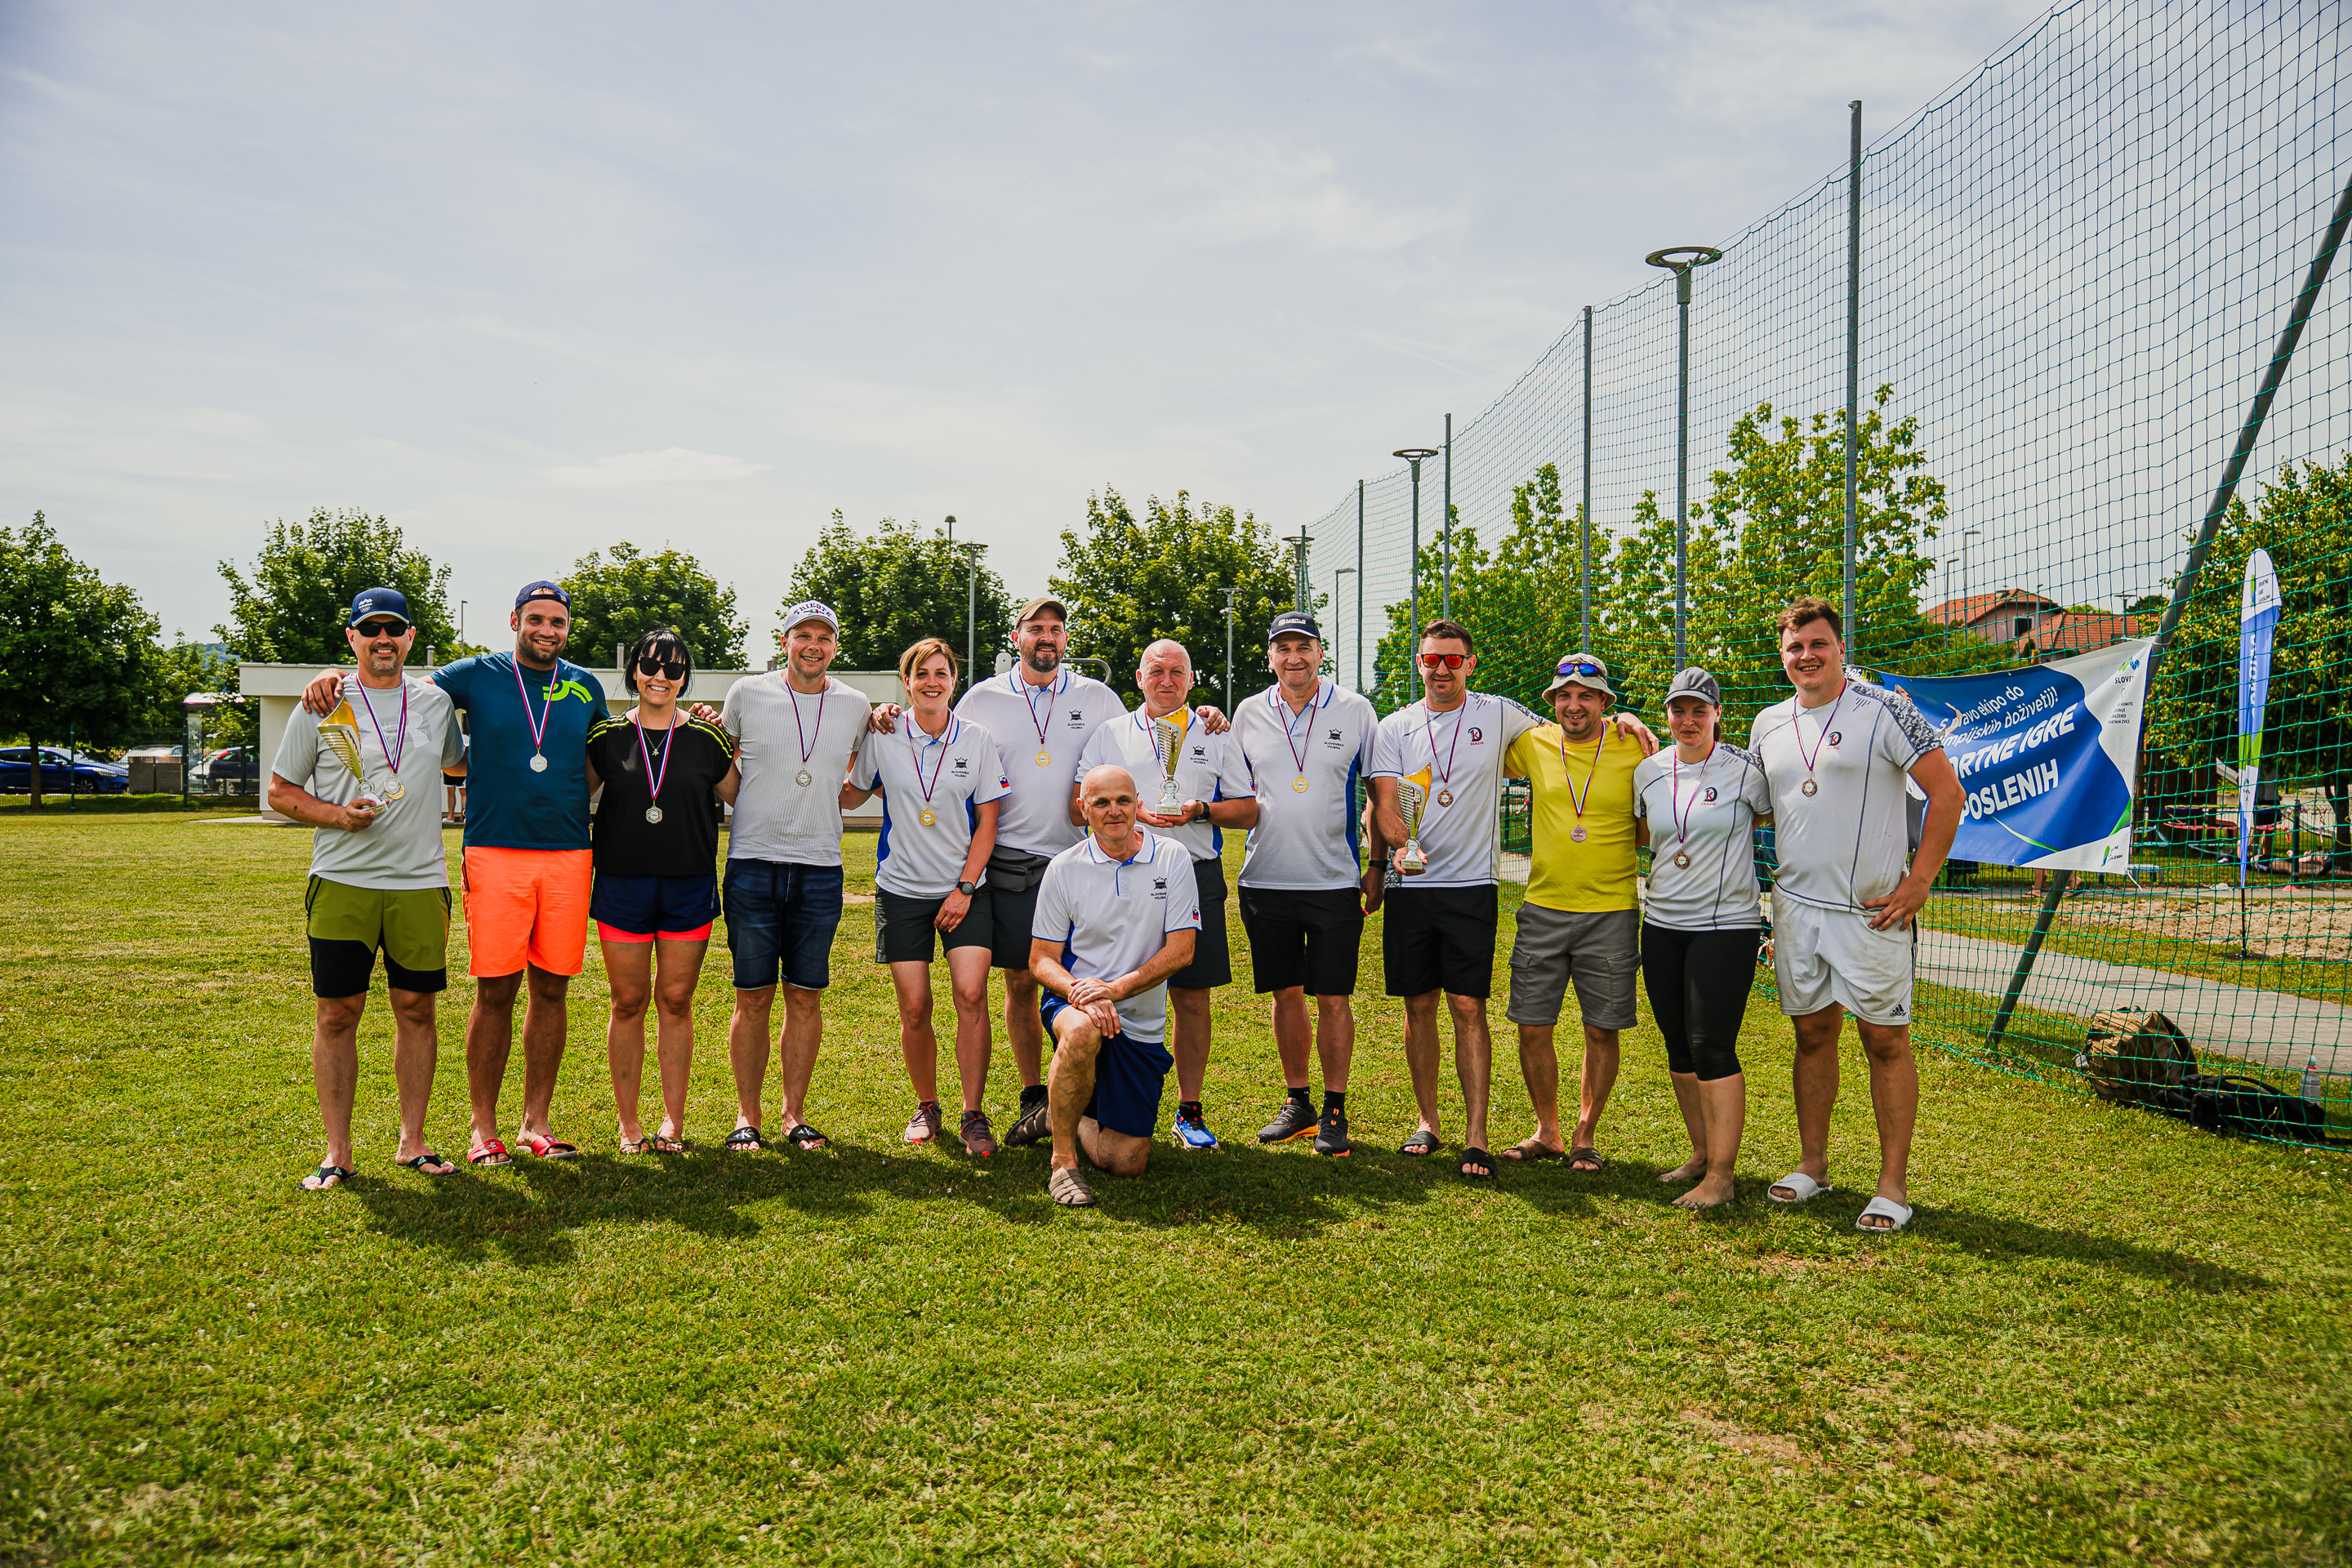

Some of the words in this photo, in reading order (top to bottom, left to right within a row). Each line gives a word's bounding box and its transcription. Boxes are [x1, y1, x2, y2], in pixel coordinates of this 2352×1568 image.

[2114, 675, 2134, 684] SLOVE
[1979, 696, 2007, 716] ekipo
[2005, 686, 2025, 701] do
[2004, 686, 2059, 728] doživetij!
[1948, 732, 2023, 779] ORTNE
[2019, 702, 2078, 754] IGRE
[1958, 759, 2059, 826] POSLENIH
